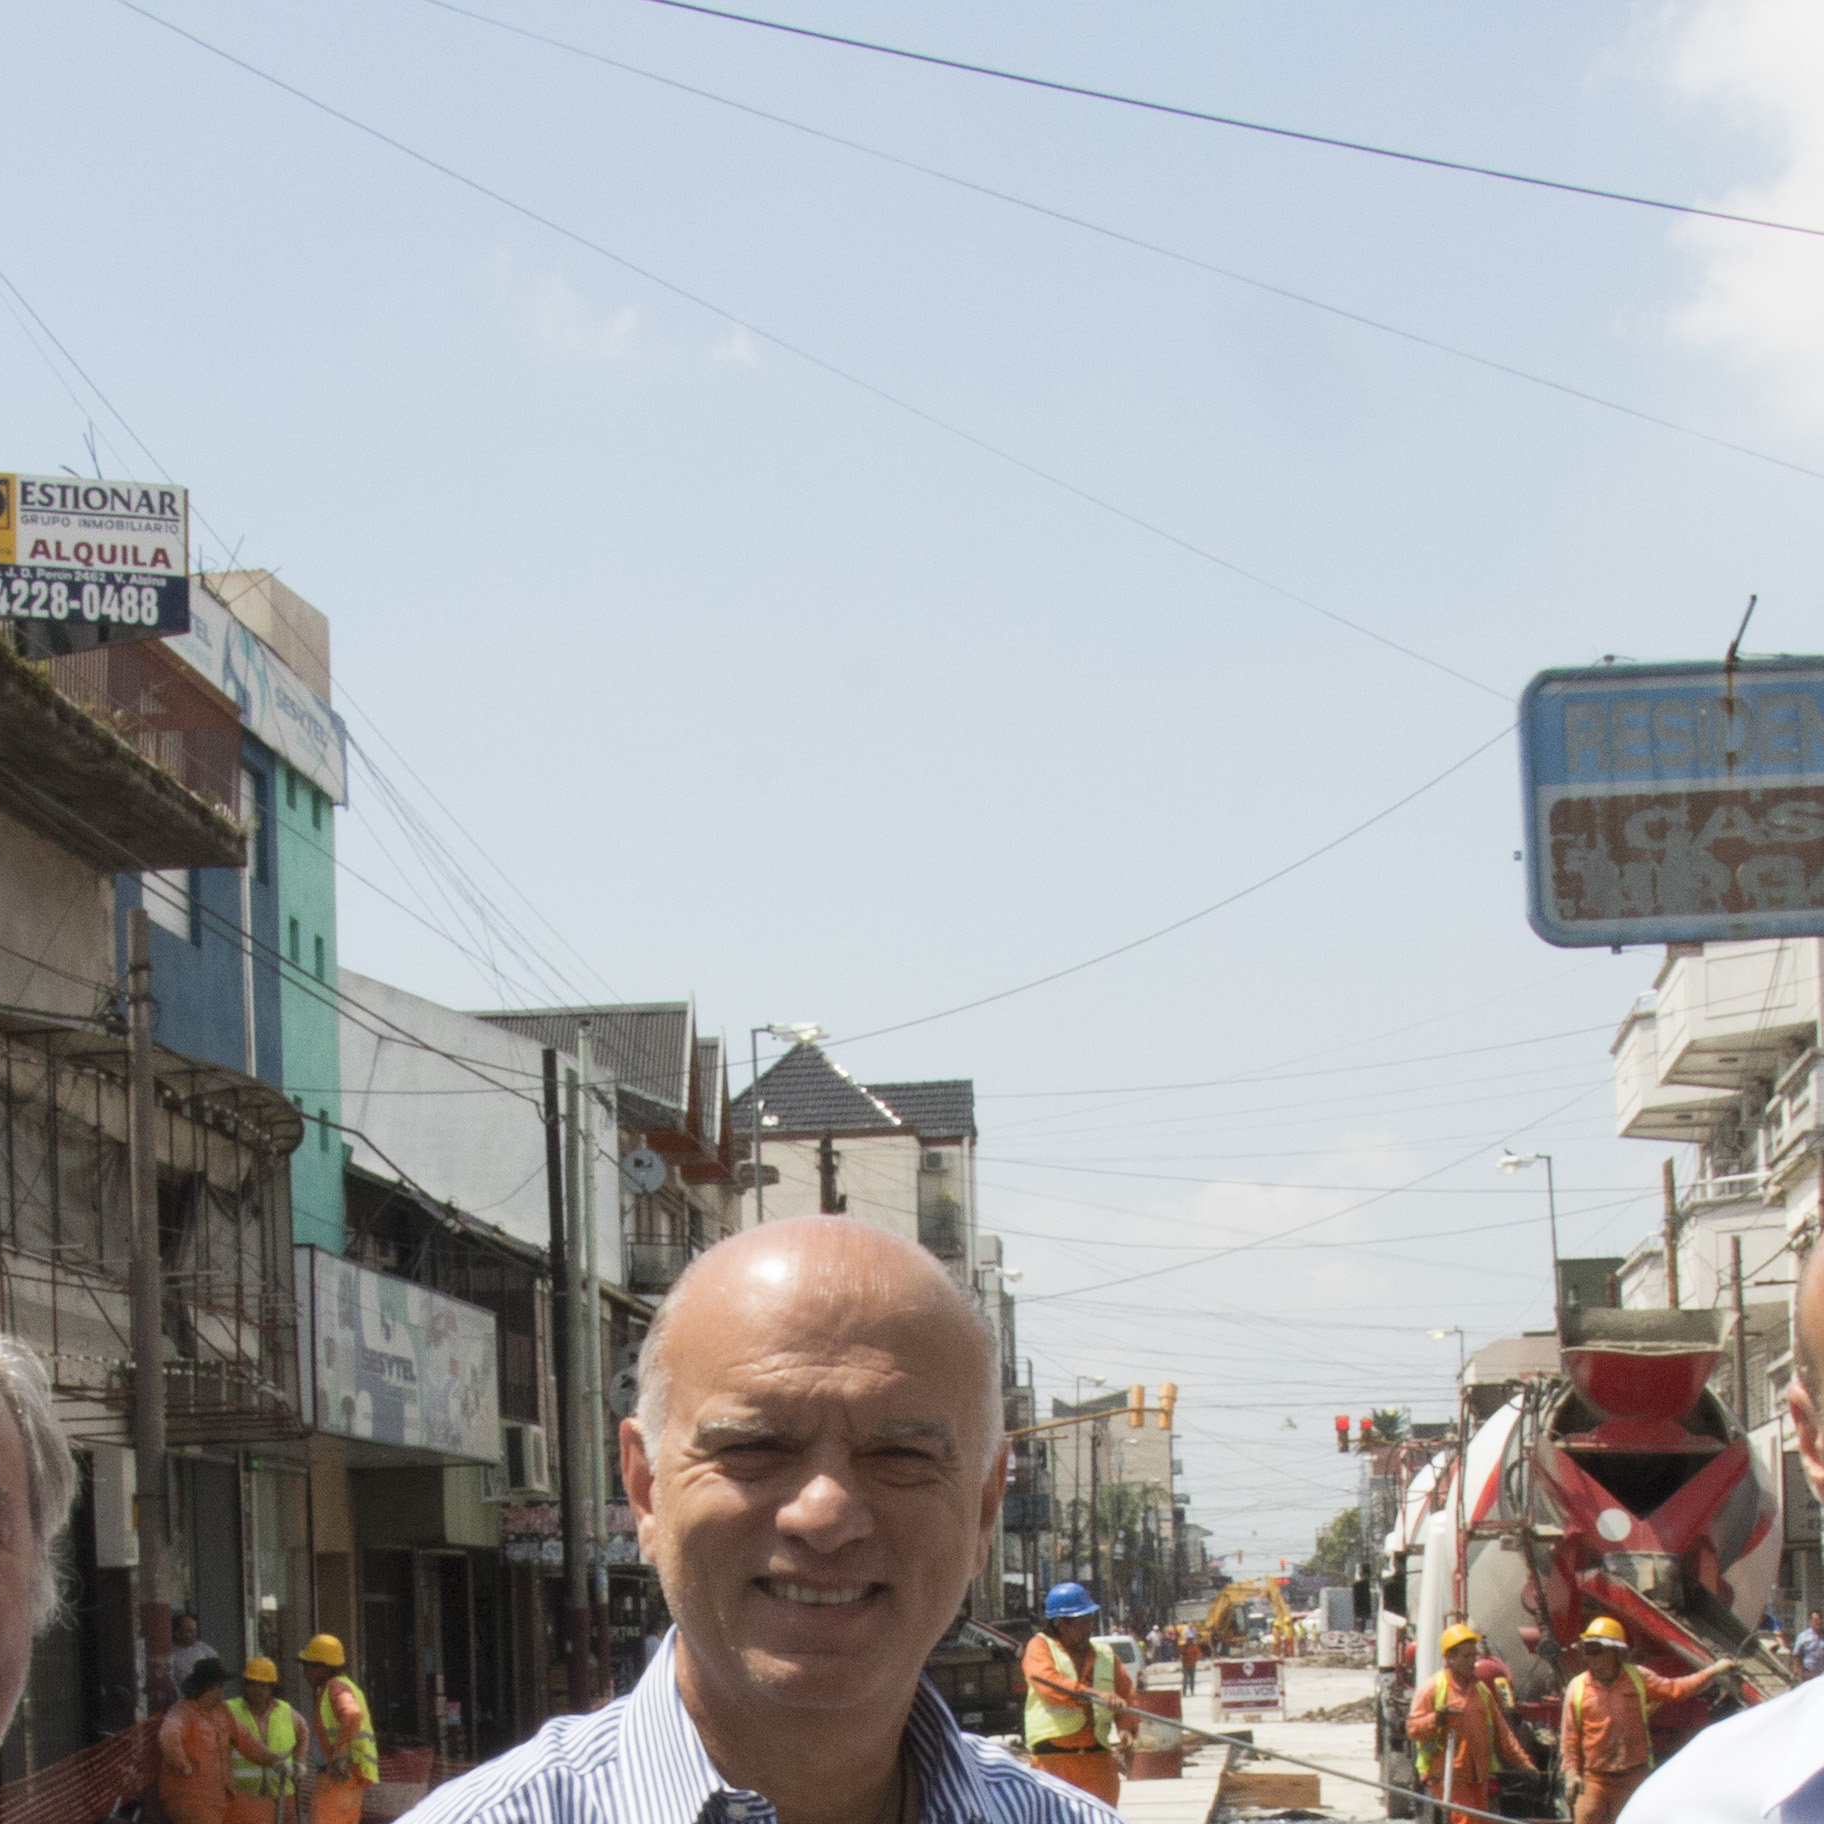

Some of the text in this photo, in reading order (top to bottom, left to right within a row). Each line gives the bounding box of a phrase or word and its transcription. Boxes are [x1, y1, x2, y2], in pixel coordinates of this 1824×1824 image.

[21, 515, 179, 535] GRUPO INMOBILIARIO
[29, 538, 172, 570] ALQUILA
